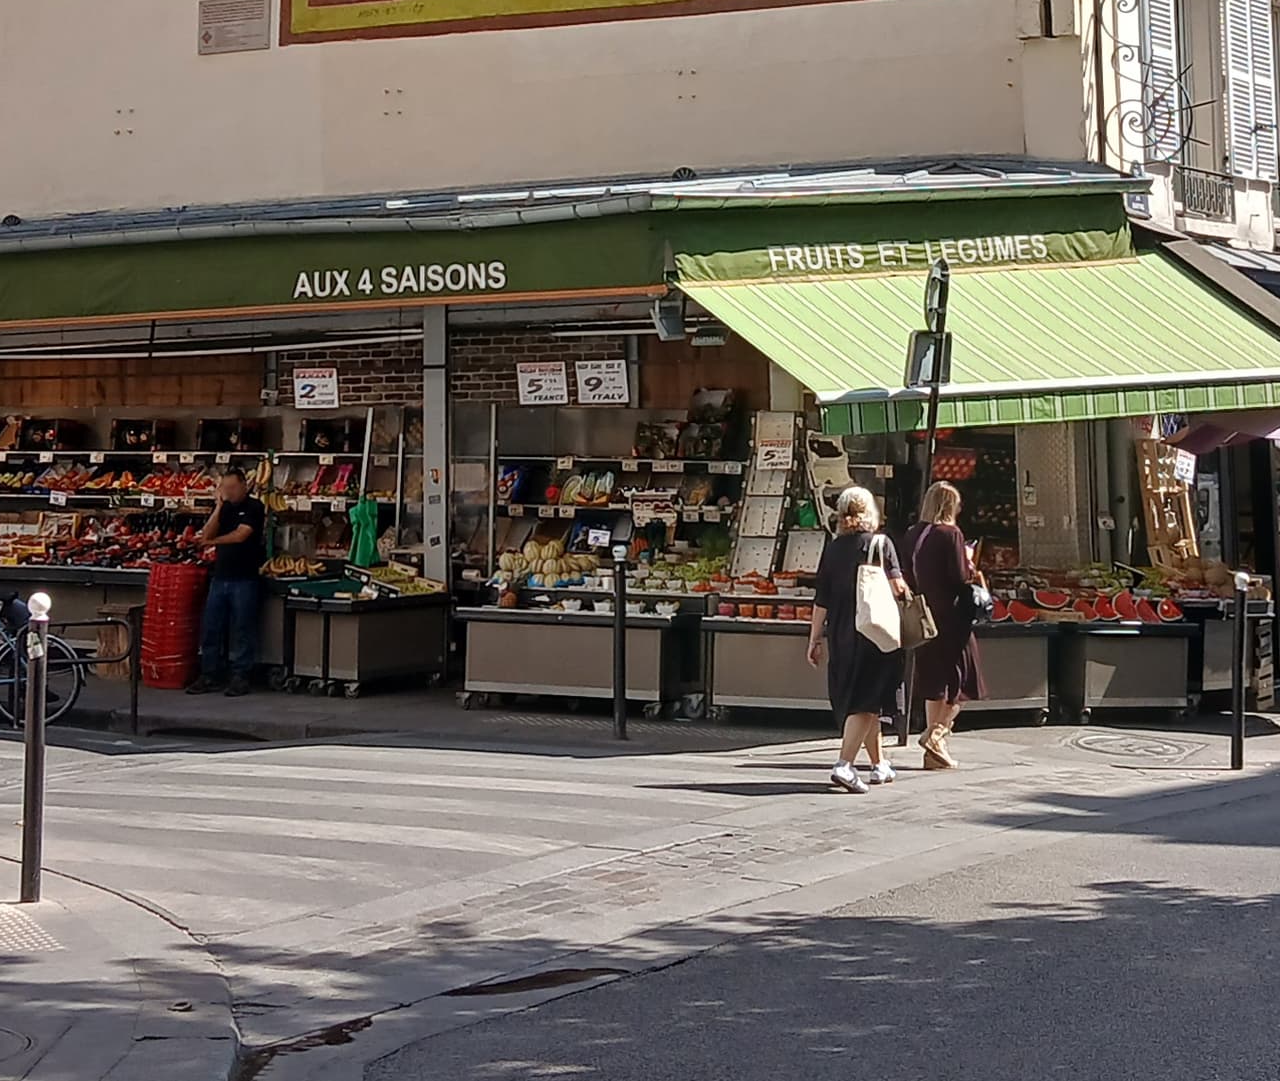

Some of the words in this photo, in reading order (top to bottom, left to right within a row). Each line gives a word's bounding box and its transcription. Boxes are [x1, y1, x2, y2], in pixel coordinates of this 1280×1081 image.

[768, 244, 865, 271] FRUITS
[877, 241, 909, 266] ET
[293, 270, 351, 298] AUX
[358, 269, 373, 295] 4
[380, 261, 506, 294] SAISONS
[299, 383, 317, 399] 2
[526, 378, 544, 394] 5
[584, 376, 603, 392] 9
[763, 450, 776, 461] 5
